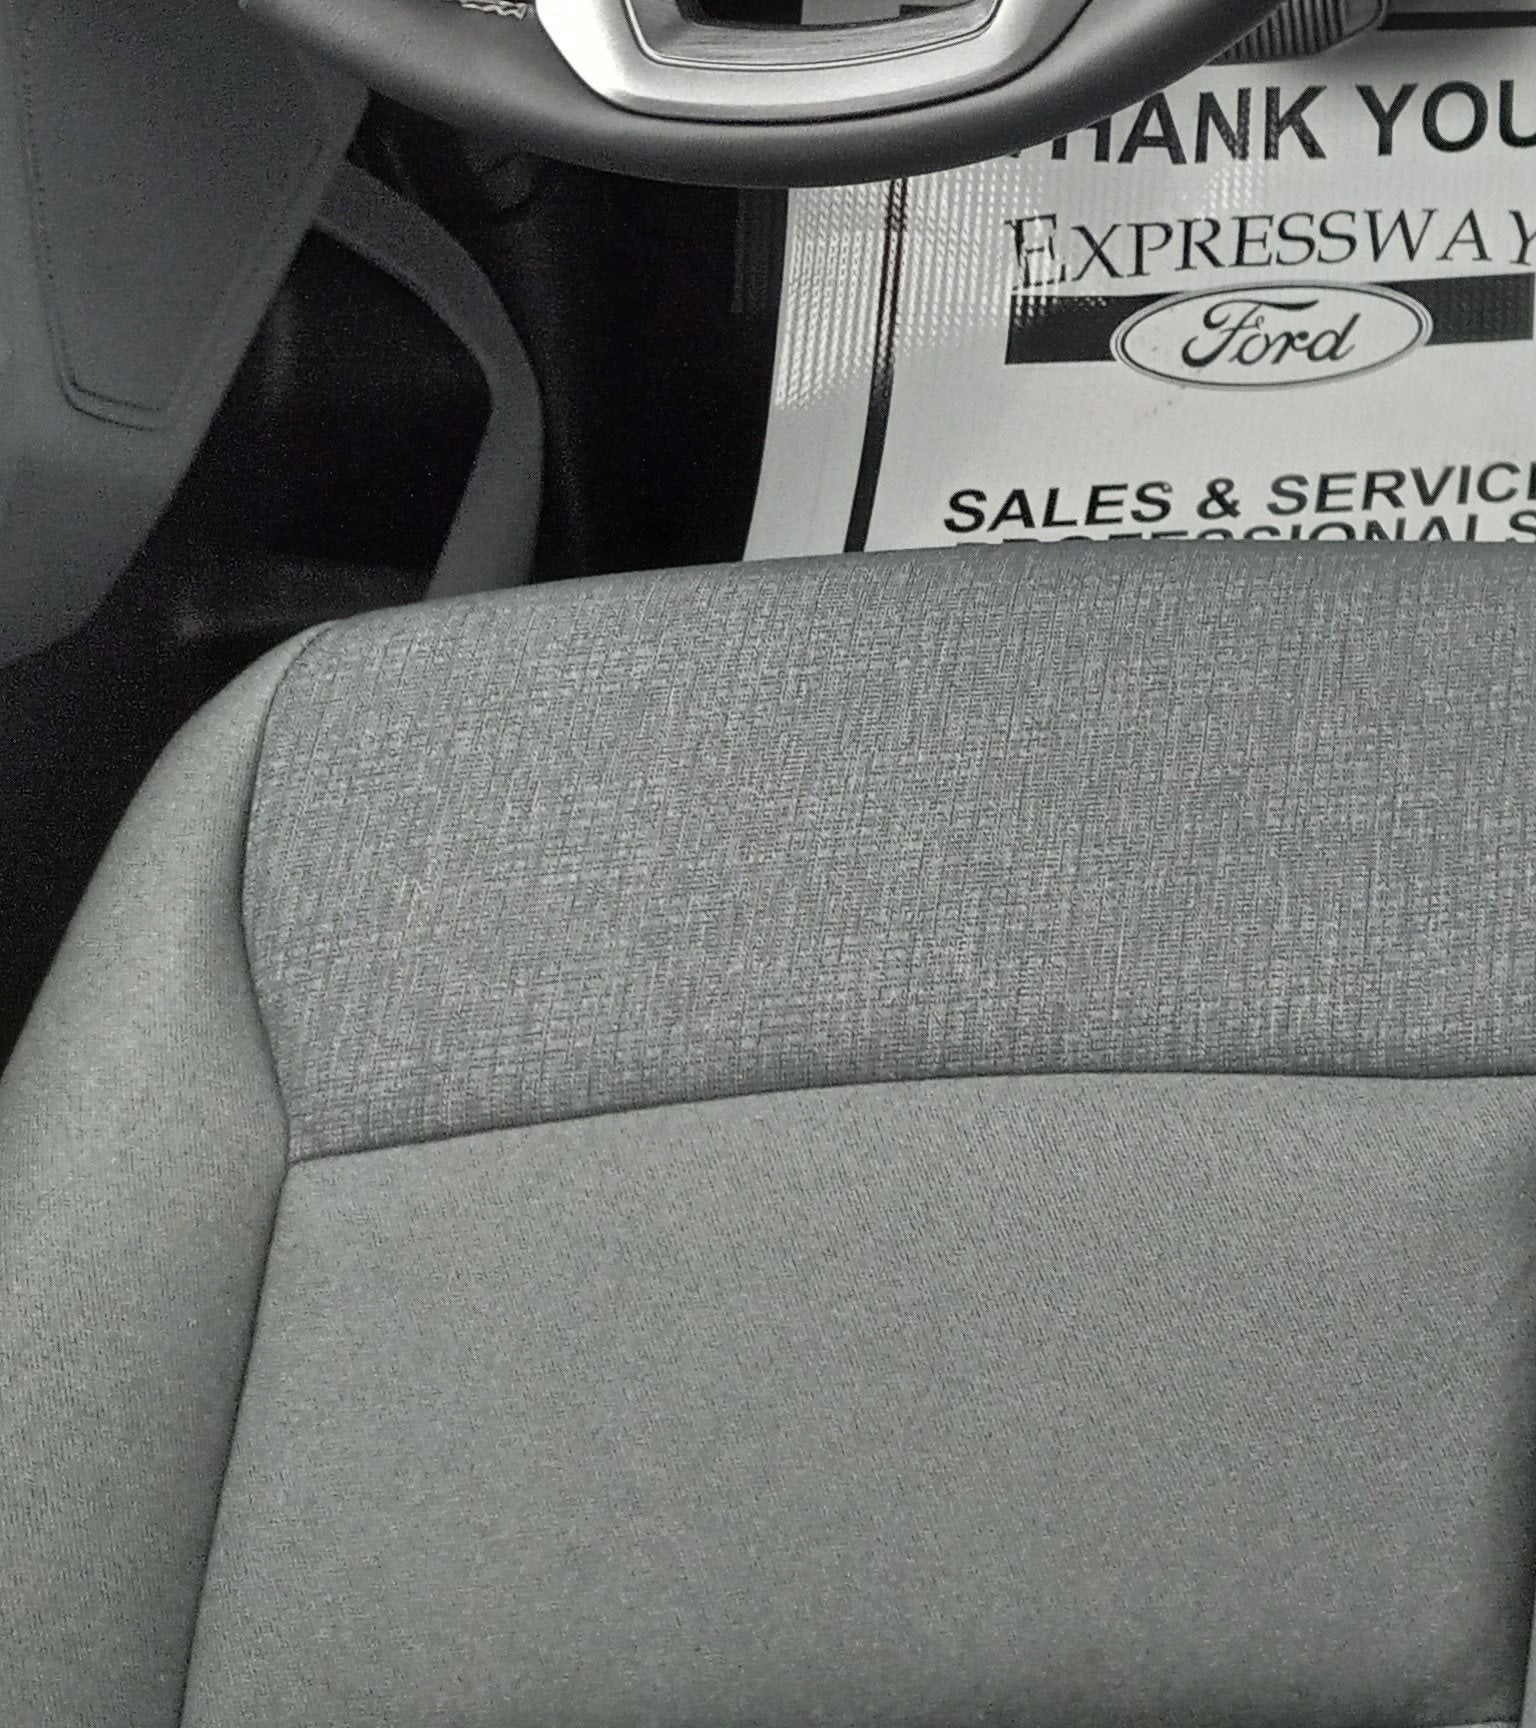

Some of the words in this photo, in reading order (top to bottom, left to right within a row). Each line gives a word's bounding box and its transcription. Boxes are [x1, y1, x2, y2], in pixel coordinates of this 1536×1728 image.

[1010, 82, 1326, 165] HANK
[1181, 299, 1361, 368] Ford
[944, 481, 1173, 533] SALES
[1197, 477, 1242, 520] &
